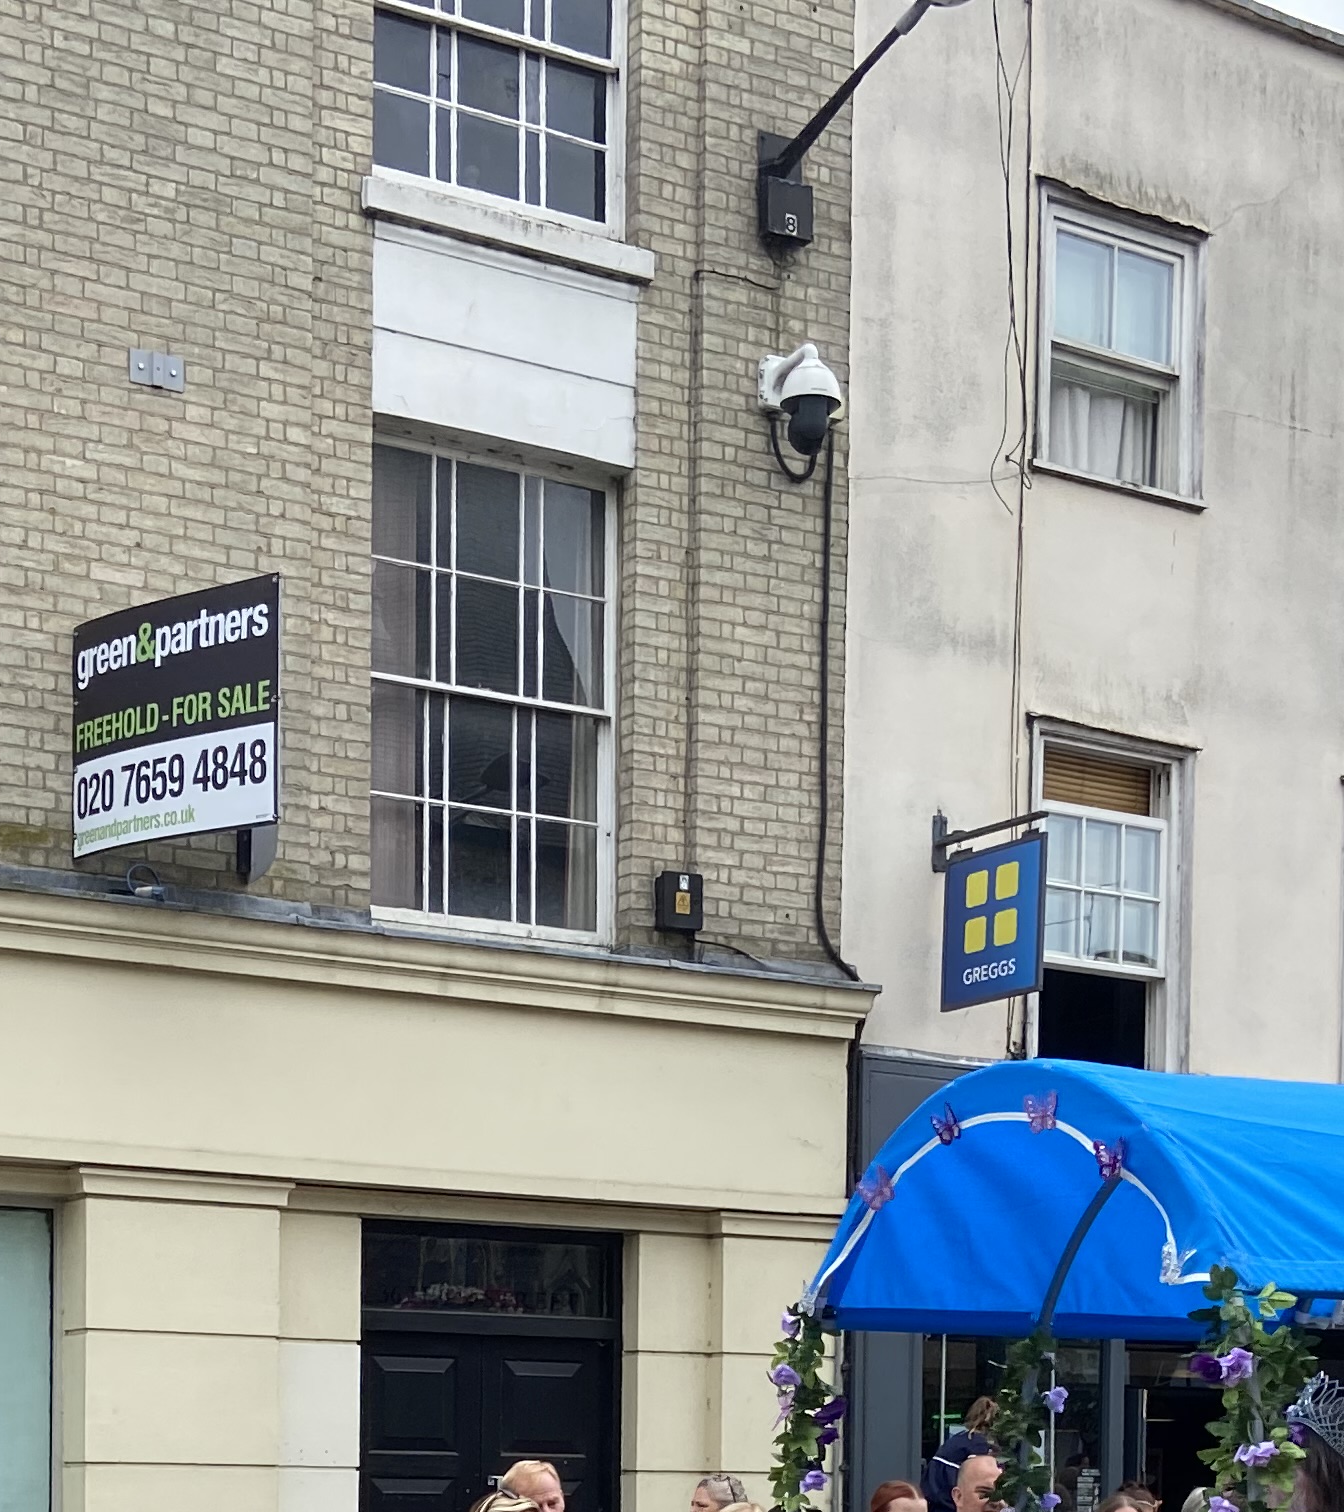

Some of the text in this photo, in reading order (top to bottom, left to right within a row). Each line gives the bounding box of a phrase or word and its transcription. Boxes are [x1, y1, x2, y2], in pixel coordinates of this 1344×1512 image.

[787, 217, 796, 233] 8
[77, 602, 270, 690] green&partners
[76, 702, 159, 753] FREEHOLD
[172, 691, 212, 728] FOR
[217, 679, 271, 718] SALE
[77, 738, 267, 820] 020 7659 4848
[76, 804, 196, 852] greenandpartners.co.uk
[962, 957, 1017, 986] GREGGS
